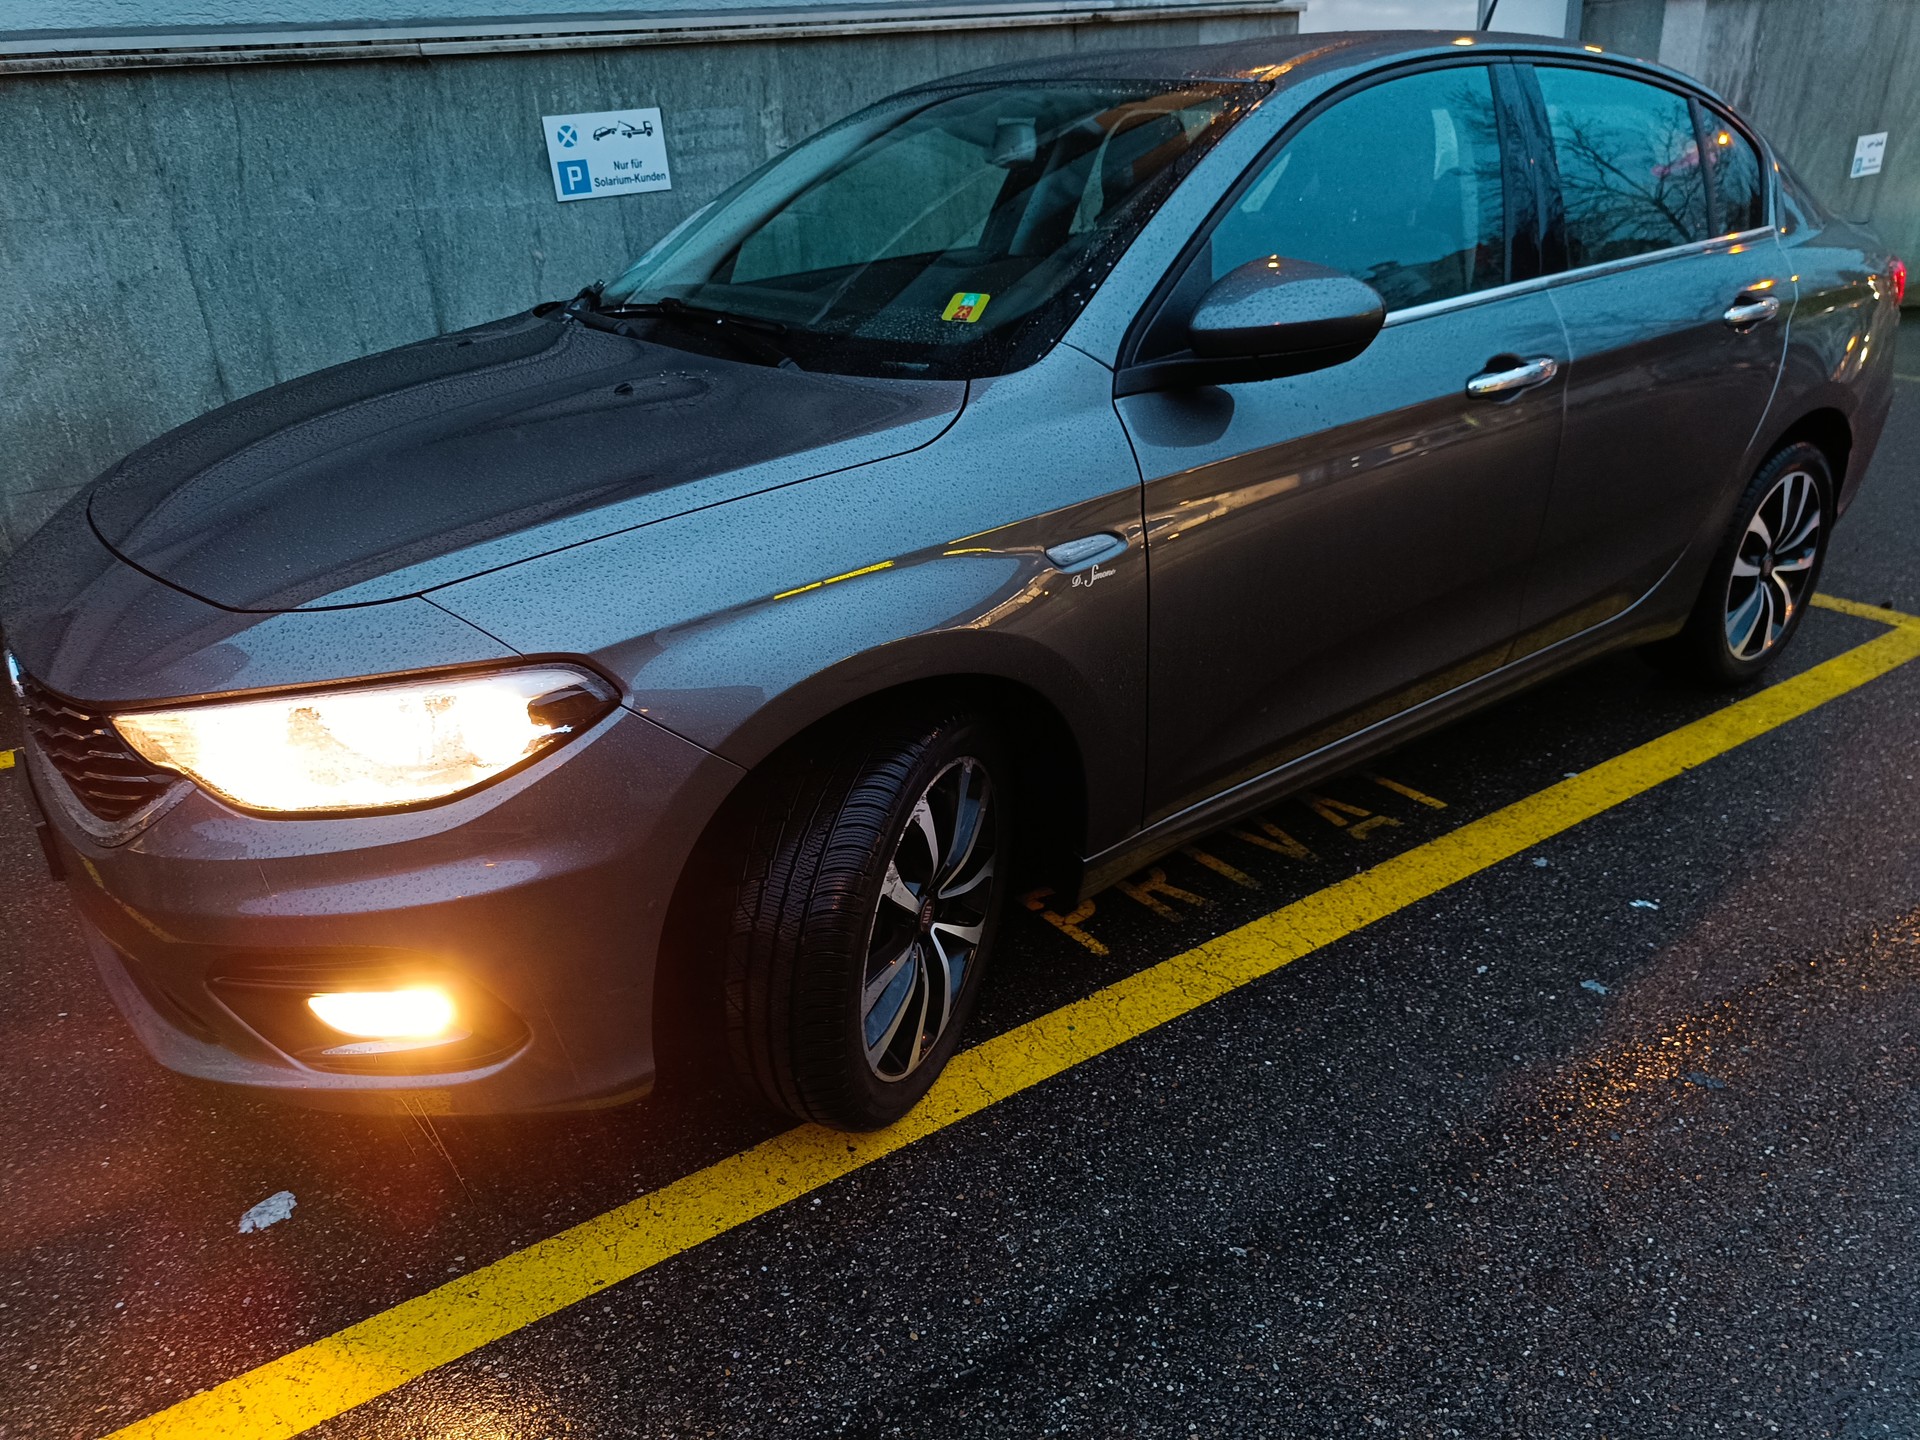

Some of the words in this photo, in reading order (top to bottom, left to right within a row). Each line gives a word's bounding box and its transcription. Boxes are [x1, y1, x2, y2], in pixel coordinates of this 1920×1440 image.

[613, 161, 629, 171] Nur
[631, 158, 643, 169] für
[566, 166, 583, 191] P
[594, 171, 667, 188] Solarium-Kunden
